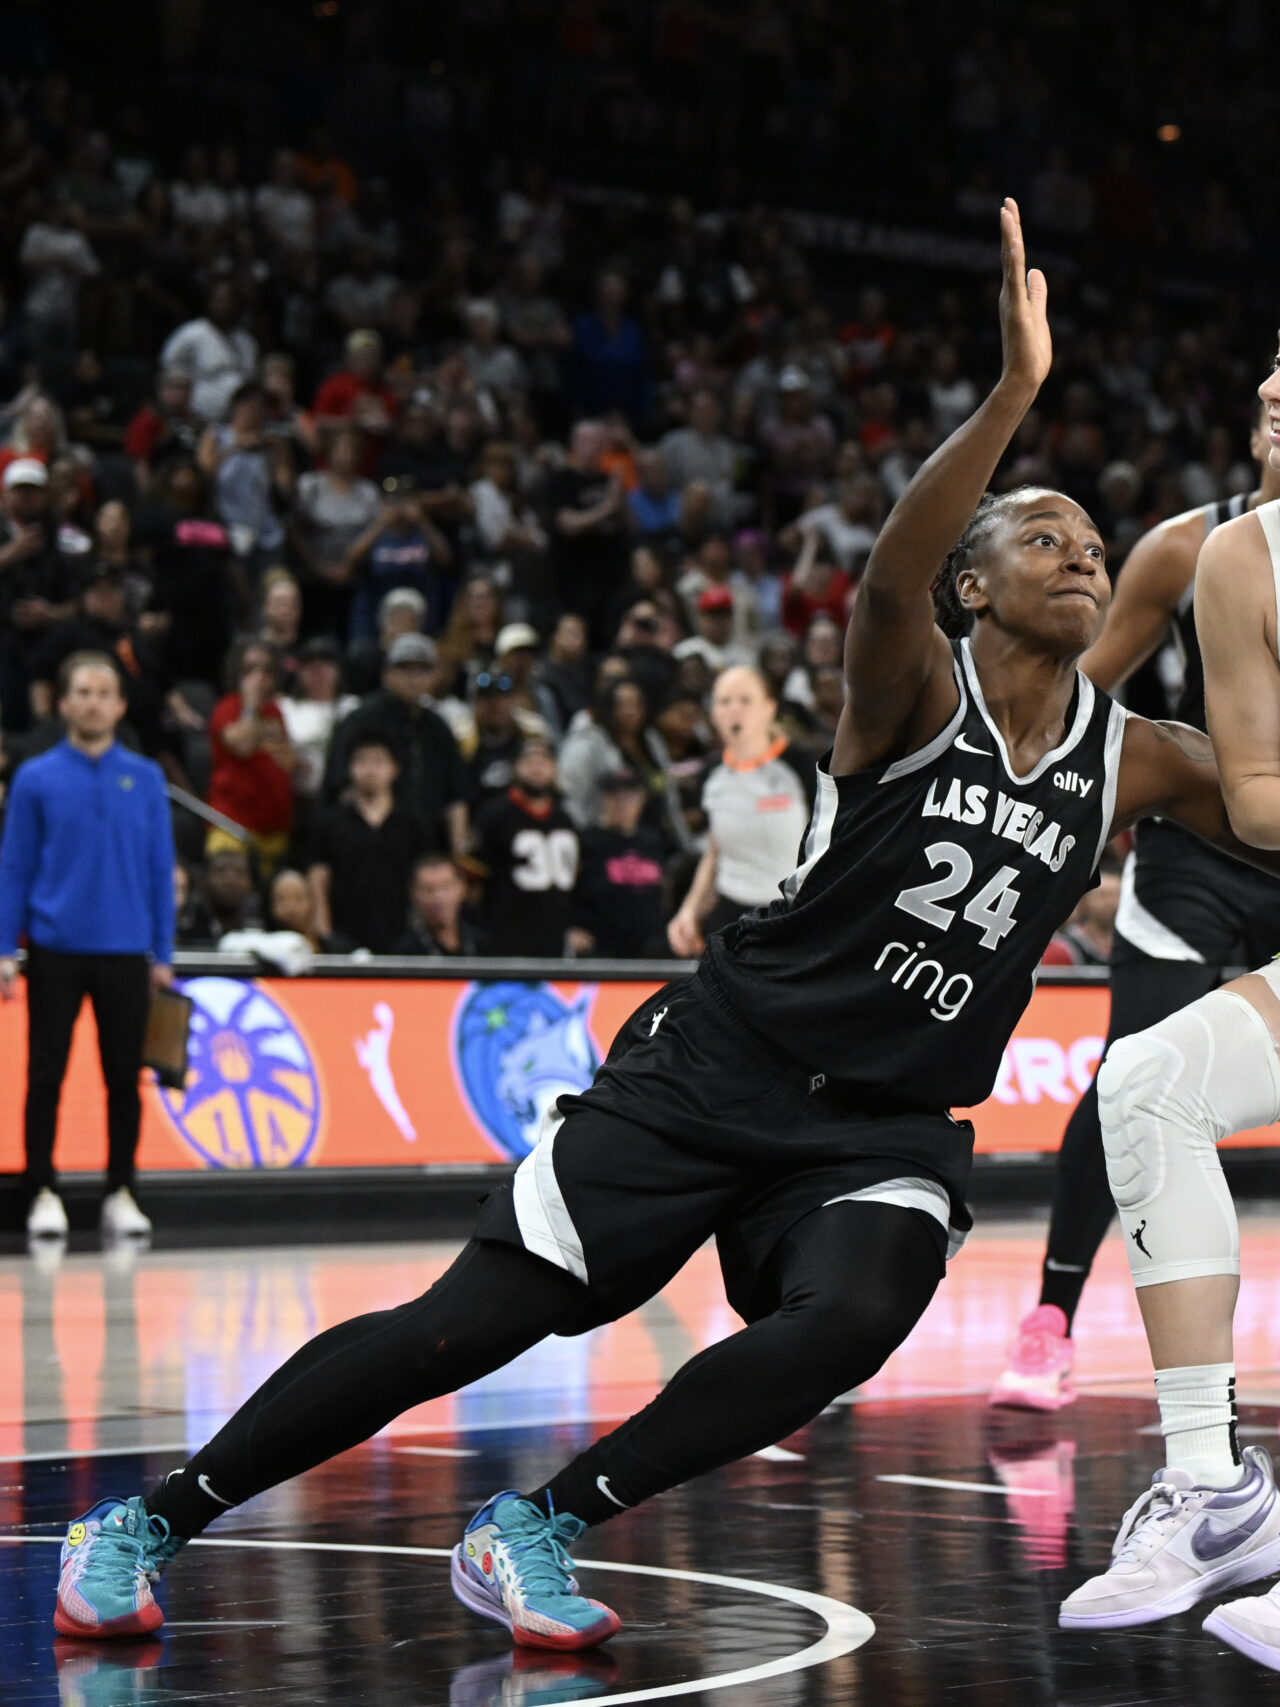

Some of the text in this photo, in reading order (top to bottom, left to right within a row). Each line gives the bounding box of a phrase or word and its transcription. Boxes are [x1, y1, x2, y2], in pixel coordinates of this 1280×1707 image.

[922, 777, 1076, 873] LAS VEGAS
[1053, 771, 1094, 798] ally
[511, 828, 580, 892] 30
[894, 841, 1021, 951] 24
[873, 940, 974, 1022] ring
